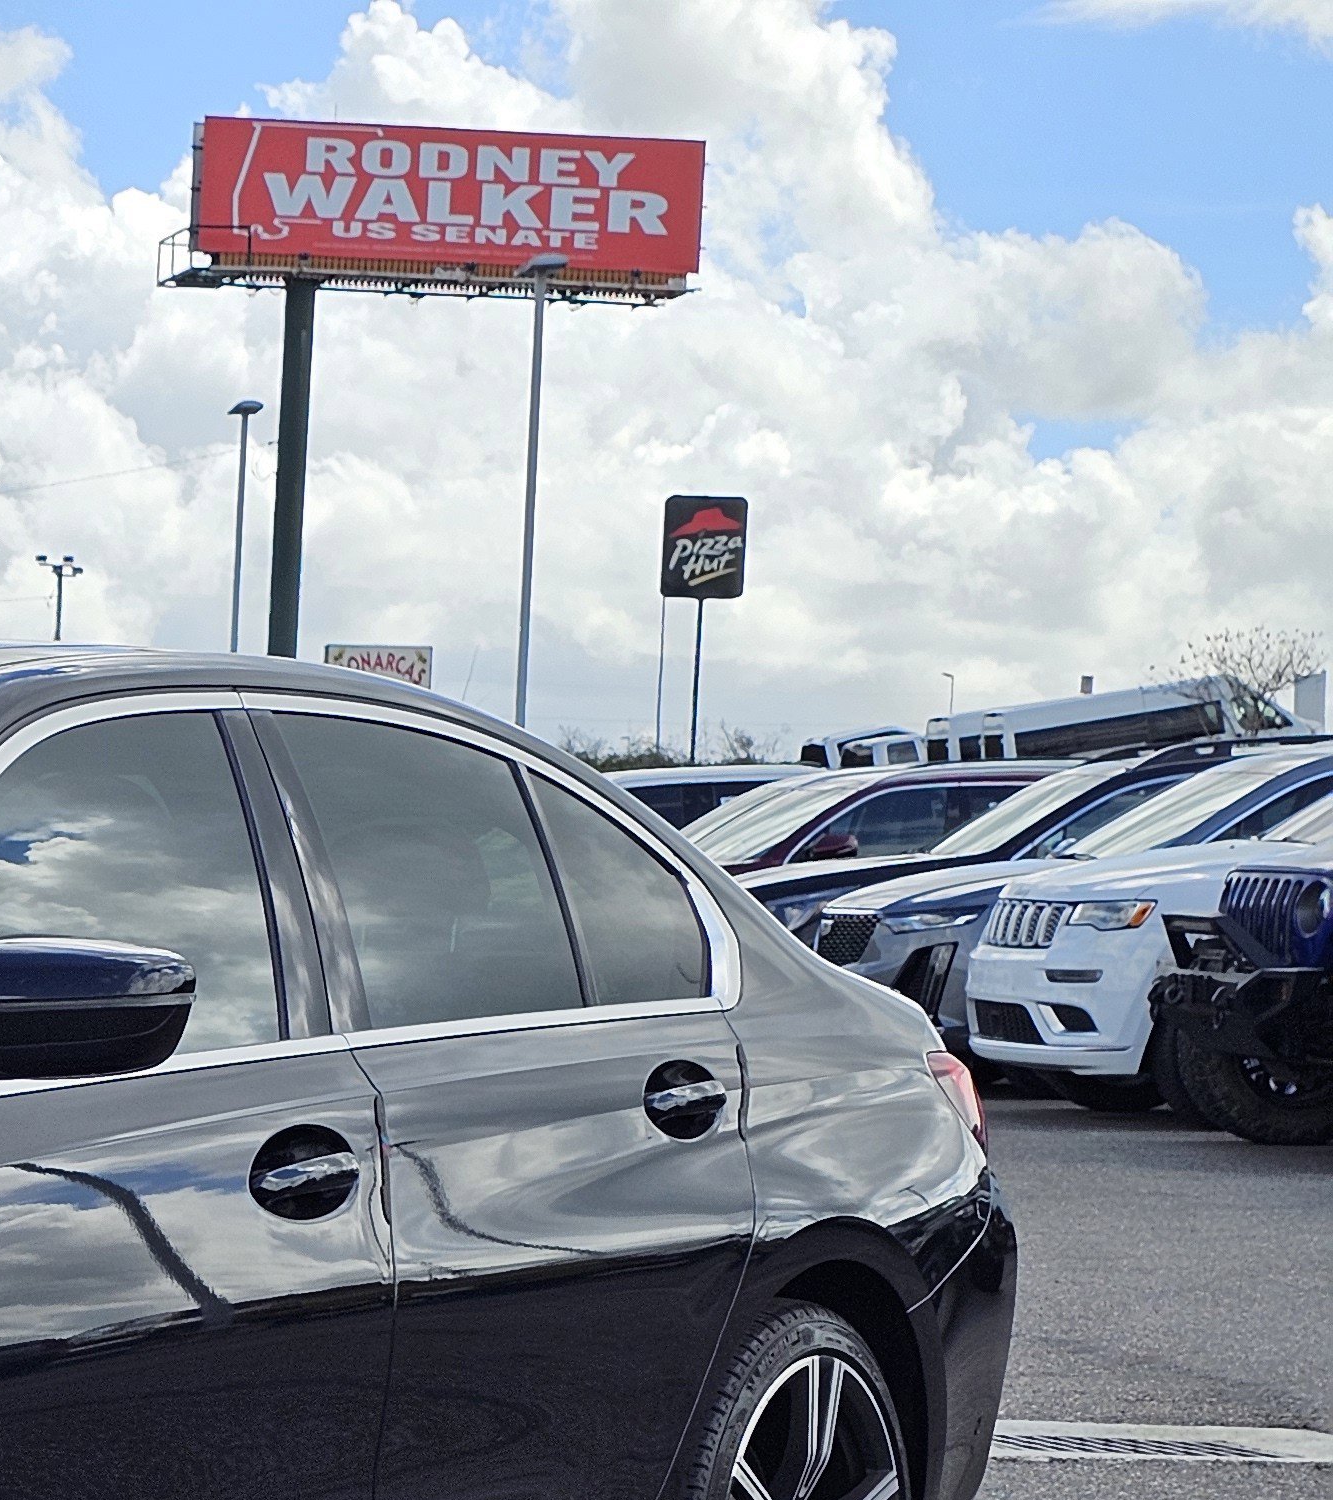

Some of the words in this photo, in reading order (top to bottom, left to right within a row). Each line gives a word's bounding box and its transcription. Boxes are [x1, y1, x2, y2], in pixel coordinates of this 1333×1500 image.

[305, 136, 636, 188] RODNEY
[263, 171, 670, 236] WALKER
[332, 220, 397, 241] US
[410, 223, 599, 251] SENATE
[669, 533, 743, 571] Pizza
[682, 551, 736, 580] Hut
[336, 651, 427, 685] ONARCAS
